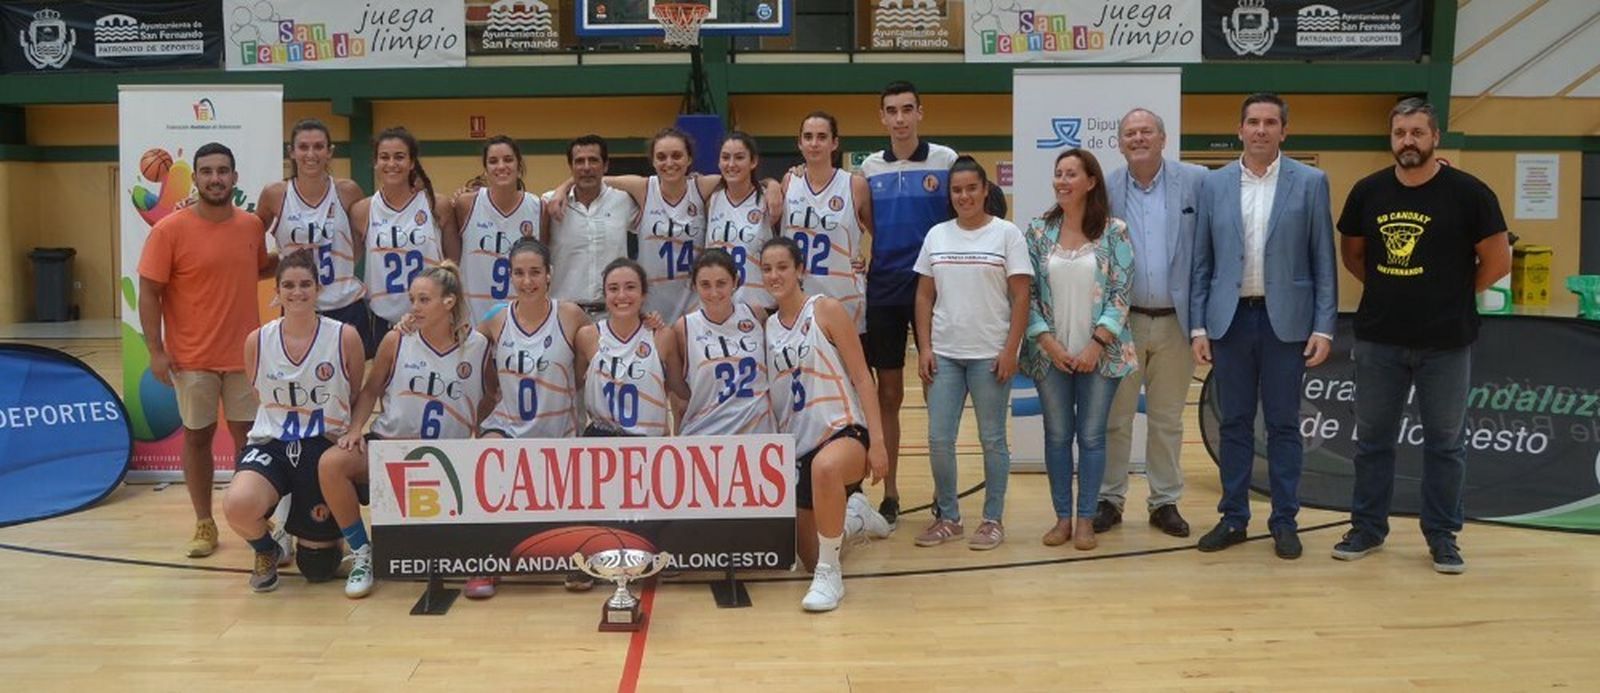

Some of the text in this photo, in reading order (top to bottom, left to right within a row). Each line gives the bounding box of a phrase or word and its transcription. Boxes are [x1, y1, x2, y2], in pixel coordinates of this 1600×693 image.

[354, 3, 434, 34] juega
[1020, 11, 1065, 33] San
[1093, 0, 1172, 27] juega
[140, 22, 191, 31] Ayuntamiento
[140, 30, 203, 40] San Fernando
[280, 20, 326, 43] San
[482, 30, 559, 39] Ayuntamiento de
[873, 28, 949, 37] Ayuntamiento de
[1110, 23, 1194, 52] limpio
[1341, 22, 1401, 31] San Fernando
[242, 33, 365, 64] Fernando
[371, 27, 457, 58] limpio
[482, 38, 559, 49] San Fernando
[873, 37, 949, 48] San Fernando
[982, 26, 1104, 54] Fernando
[1088, 136, 1103, 148] de
[652, 217, 698, 238] CBG
[790, 206, 838, 231] CBG
[291, 221, 335, 245] CBG
[376, 226, 426, 249] CBG
[479, 231, 512, 255] CB
[711, 220, 756, 243] CBG
[658, 240, 694, 280] 14
[793, 231, 831, 275] 92
[384, 250, 424, 294] 22
[491, 257, 510, 300] 9
[705, 335, 757, 360] CBG
[505, 350, 549, 374] CBG
[409, 371, 463, 400] CBG
[715, 356, 756, 404] 32
[273, 382, 331, 407] CBG
[518, 377, 538, 421] 0
[603, 381, 639, 428] 10
[1467, 383, 1600, 416] ndaluz
[420, 400, 443, 439] 6
[1300, 411, 1340, 439] de
[474, 442, 787, 514] CAMPEONAS
[389, 554, 510, 574] FEDERACIÓN
[516, 555, 580, 573] ANDAL
